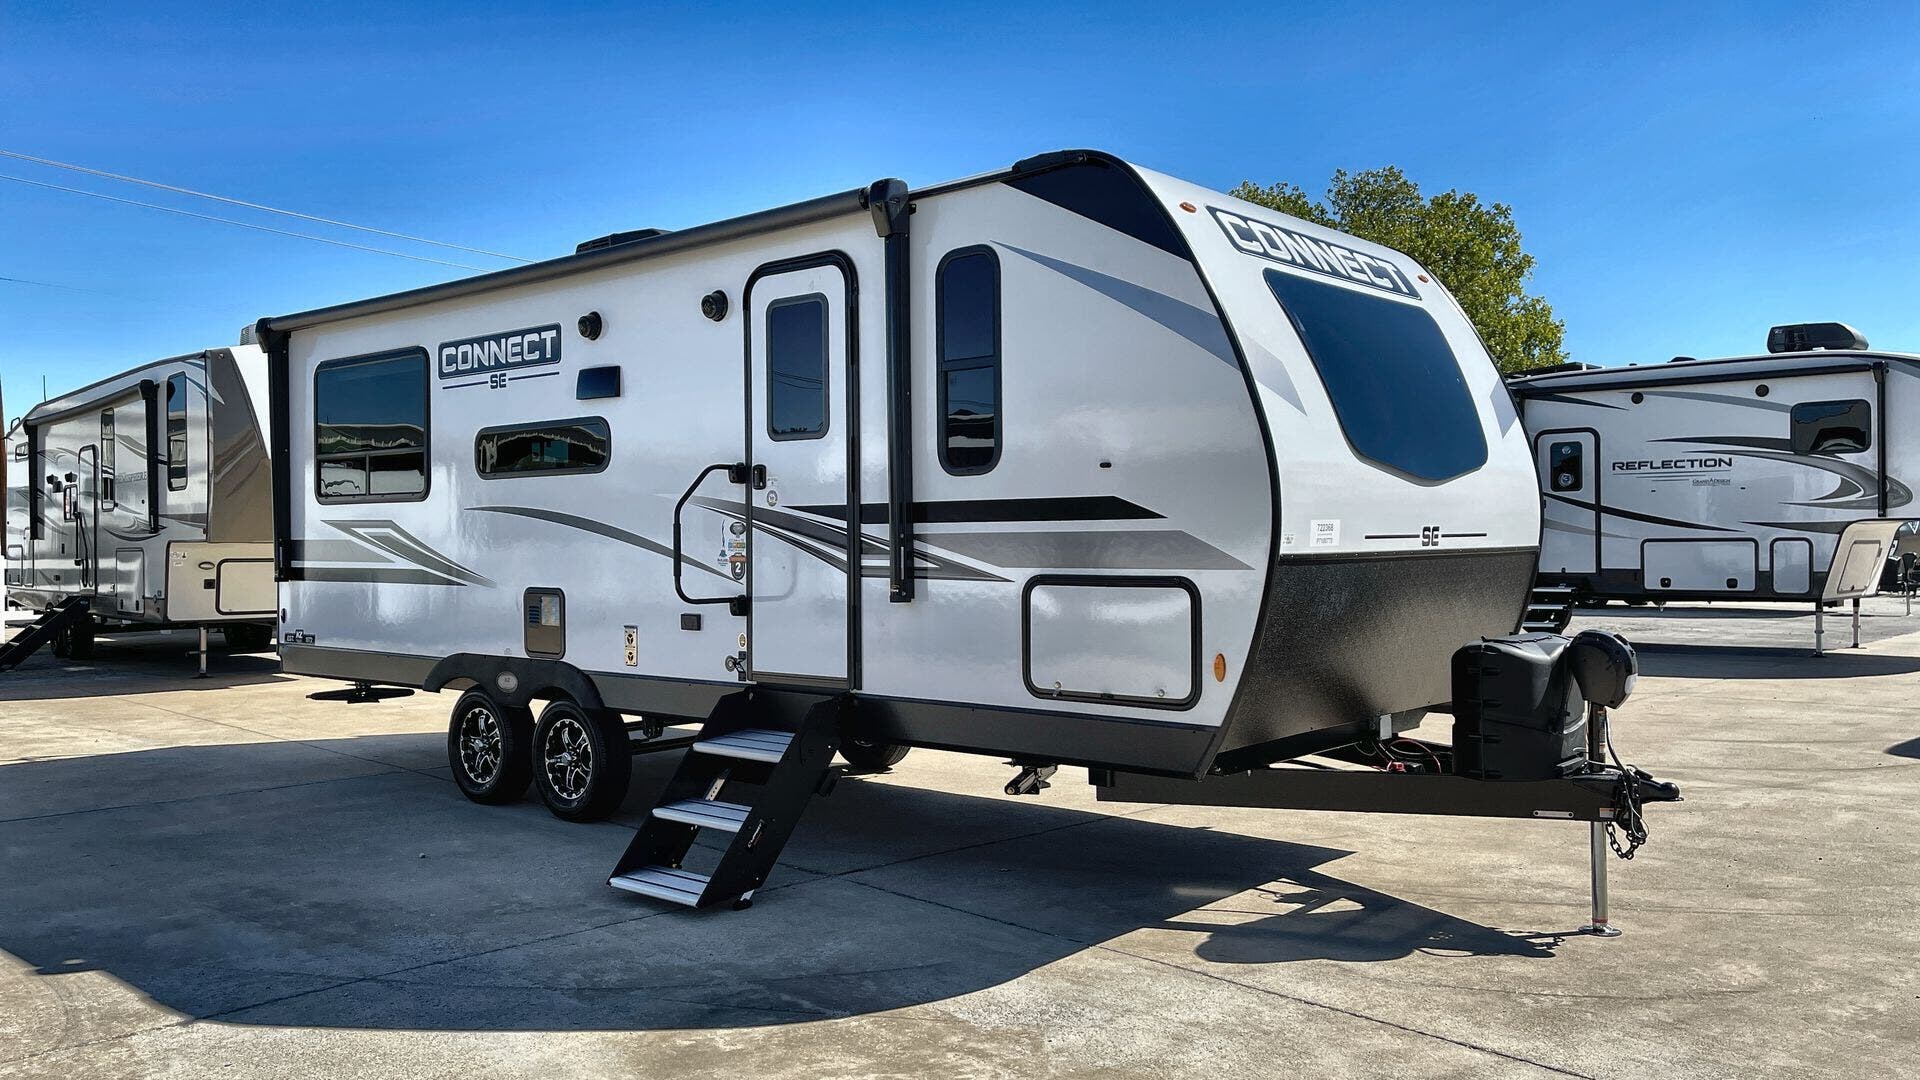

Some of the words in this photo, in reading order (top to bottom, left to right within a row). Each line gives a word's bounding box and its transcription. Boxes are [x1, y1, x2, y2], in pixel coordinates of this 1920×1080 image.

[1215, 210, 1410, 294] CONNECT
[441, 329, 557, 373] CONNECT
[489, 373, 507, 389] SE
[1612, 457, 1733, 471] REFLECTION
[1421, 526, 1440, 546] SE
[735, 561, 742, 573] 2
